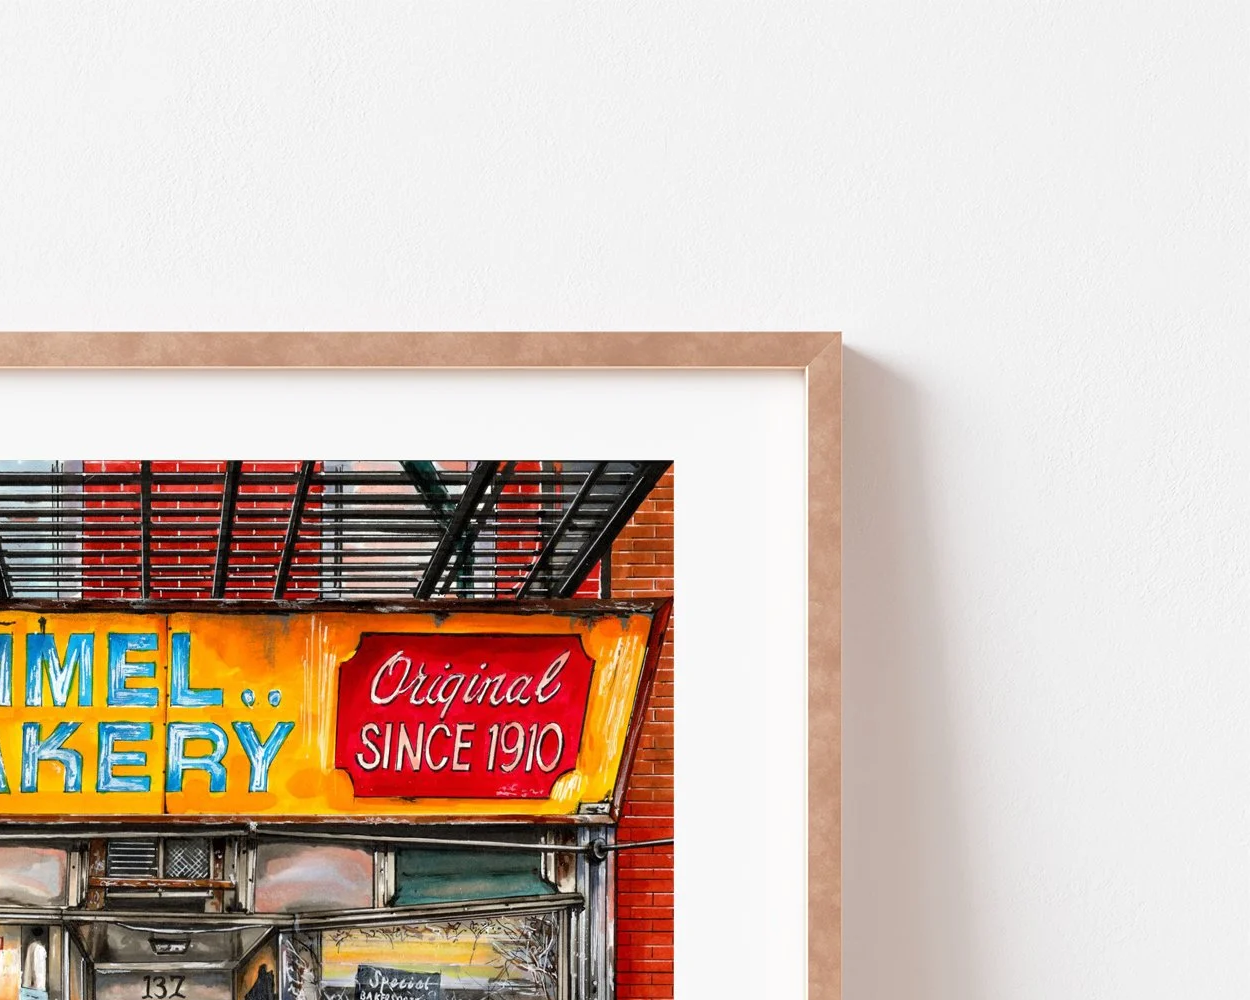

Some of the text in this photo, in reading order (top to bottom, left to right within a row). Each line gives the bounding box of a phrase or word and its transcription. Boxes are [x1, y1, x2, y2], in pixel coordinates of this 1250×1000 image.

[371, 650, 571, 720] Original
[356, 721, 565, 773] SINCE 1910
[370, 969, 431, 994] Special
